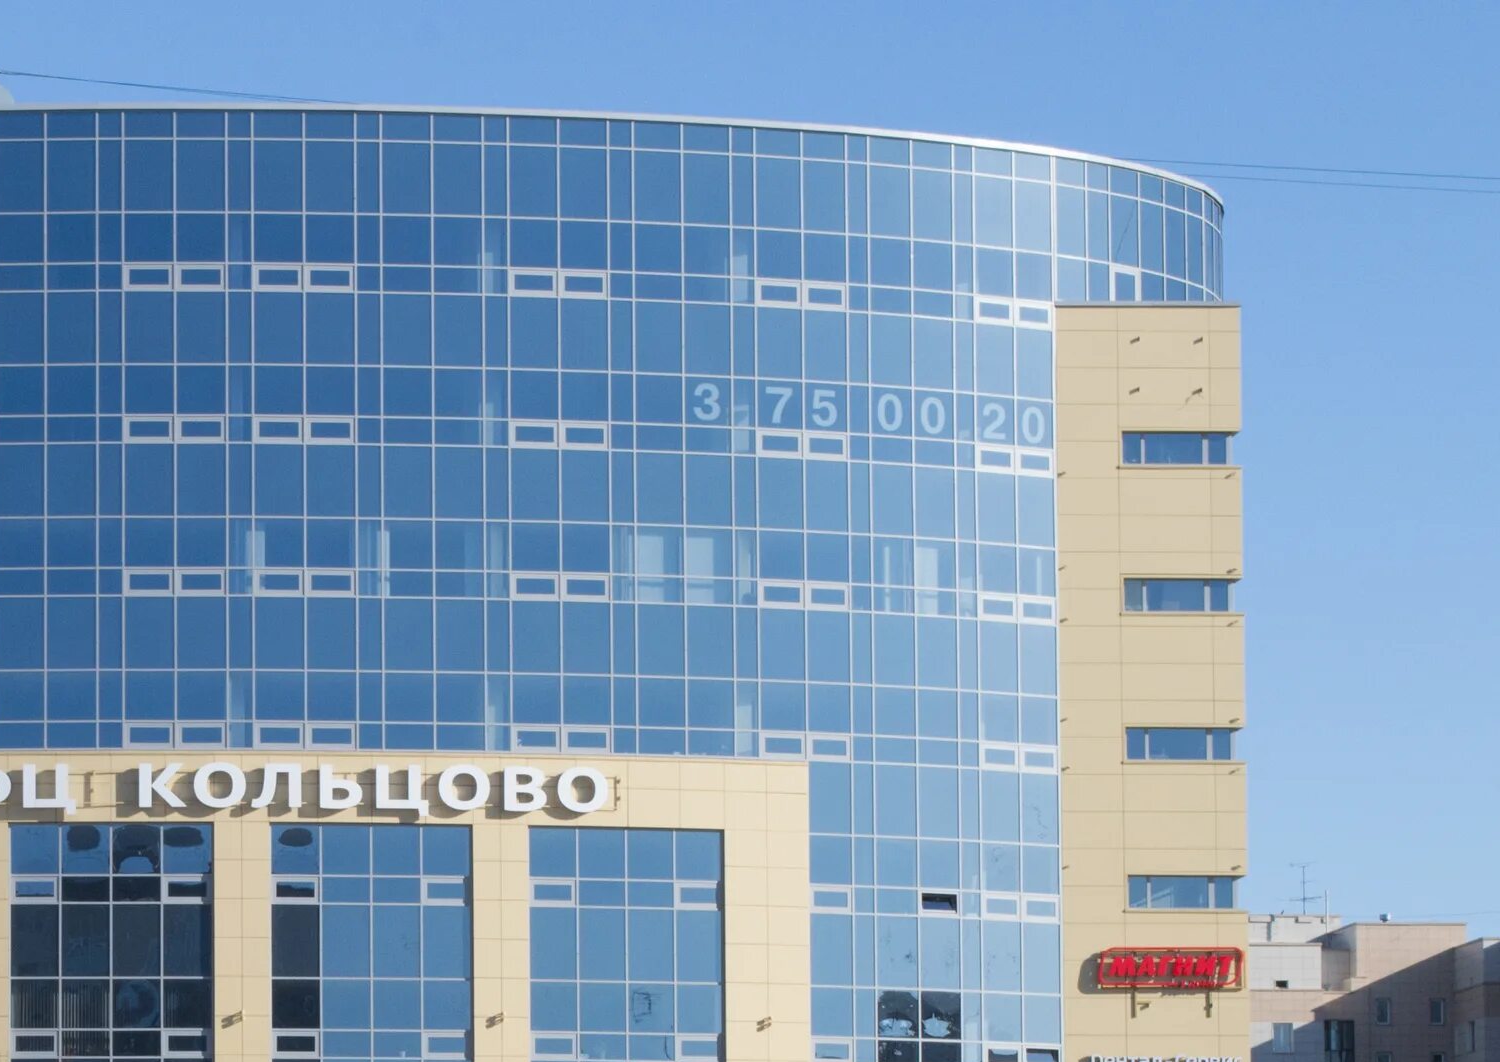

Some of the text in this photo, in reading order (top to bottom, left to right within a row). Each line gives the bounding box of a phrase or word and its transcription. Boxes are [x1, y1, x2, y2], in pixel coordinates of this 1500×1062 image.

[764, 385, 838, 427] 75
[877, 393, 946, 435] 00
[982, 402, 1045, 444] 20
[138, 762, 609, 817] КОЛЬЦОВО
[1111, 955, 1234, 976] МАГНИТ
